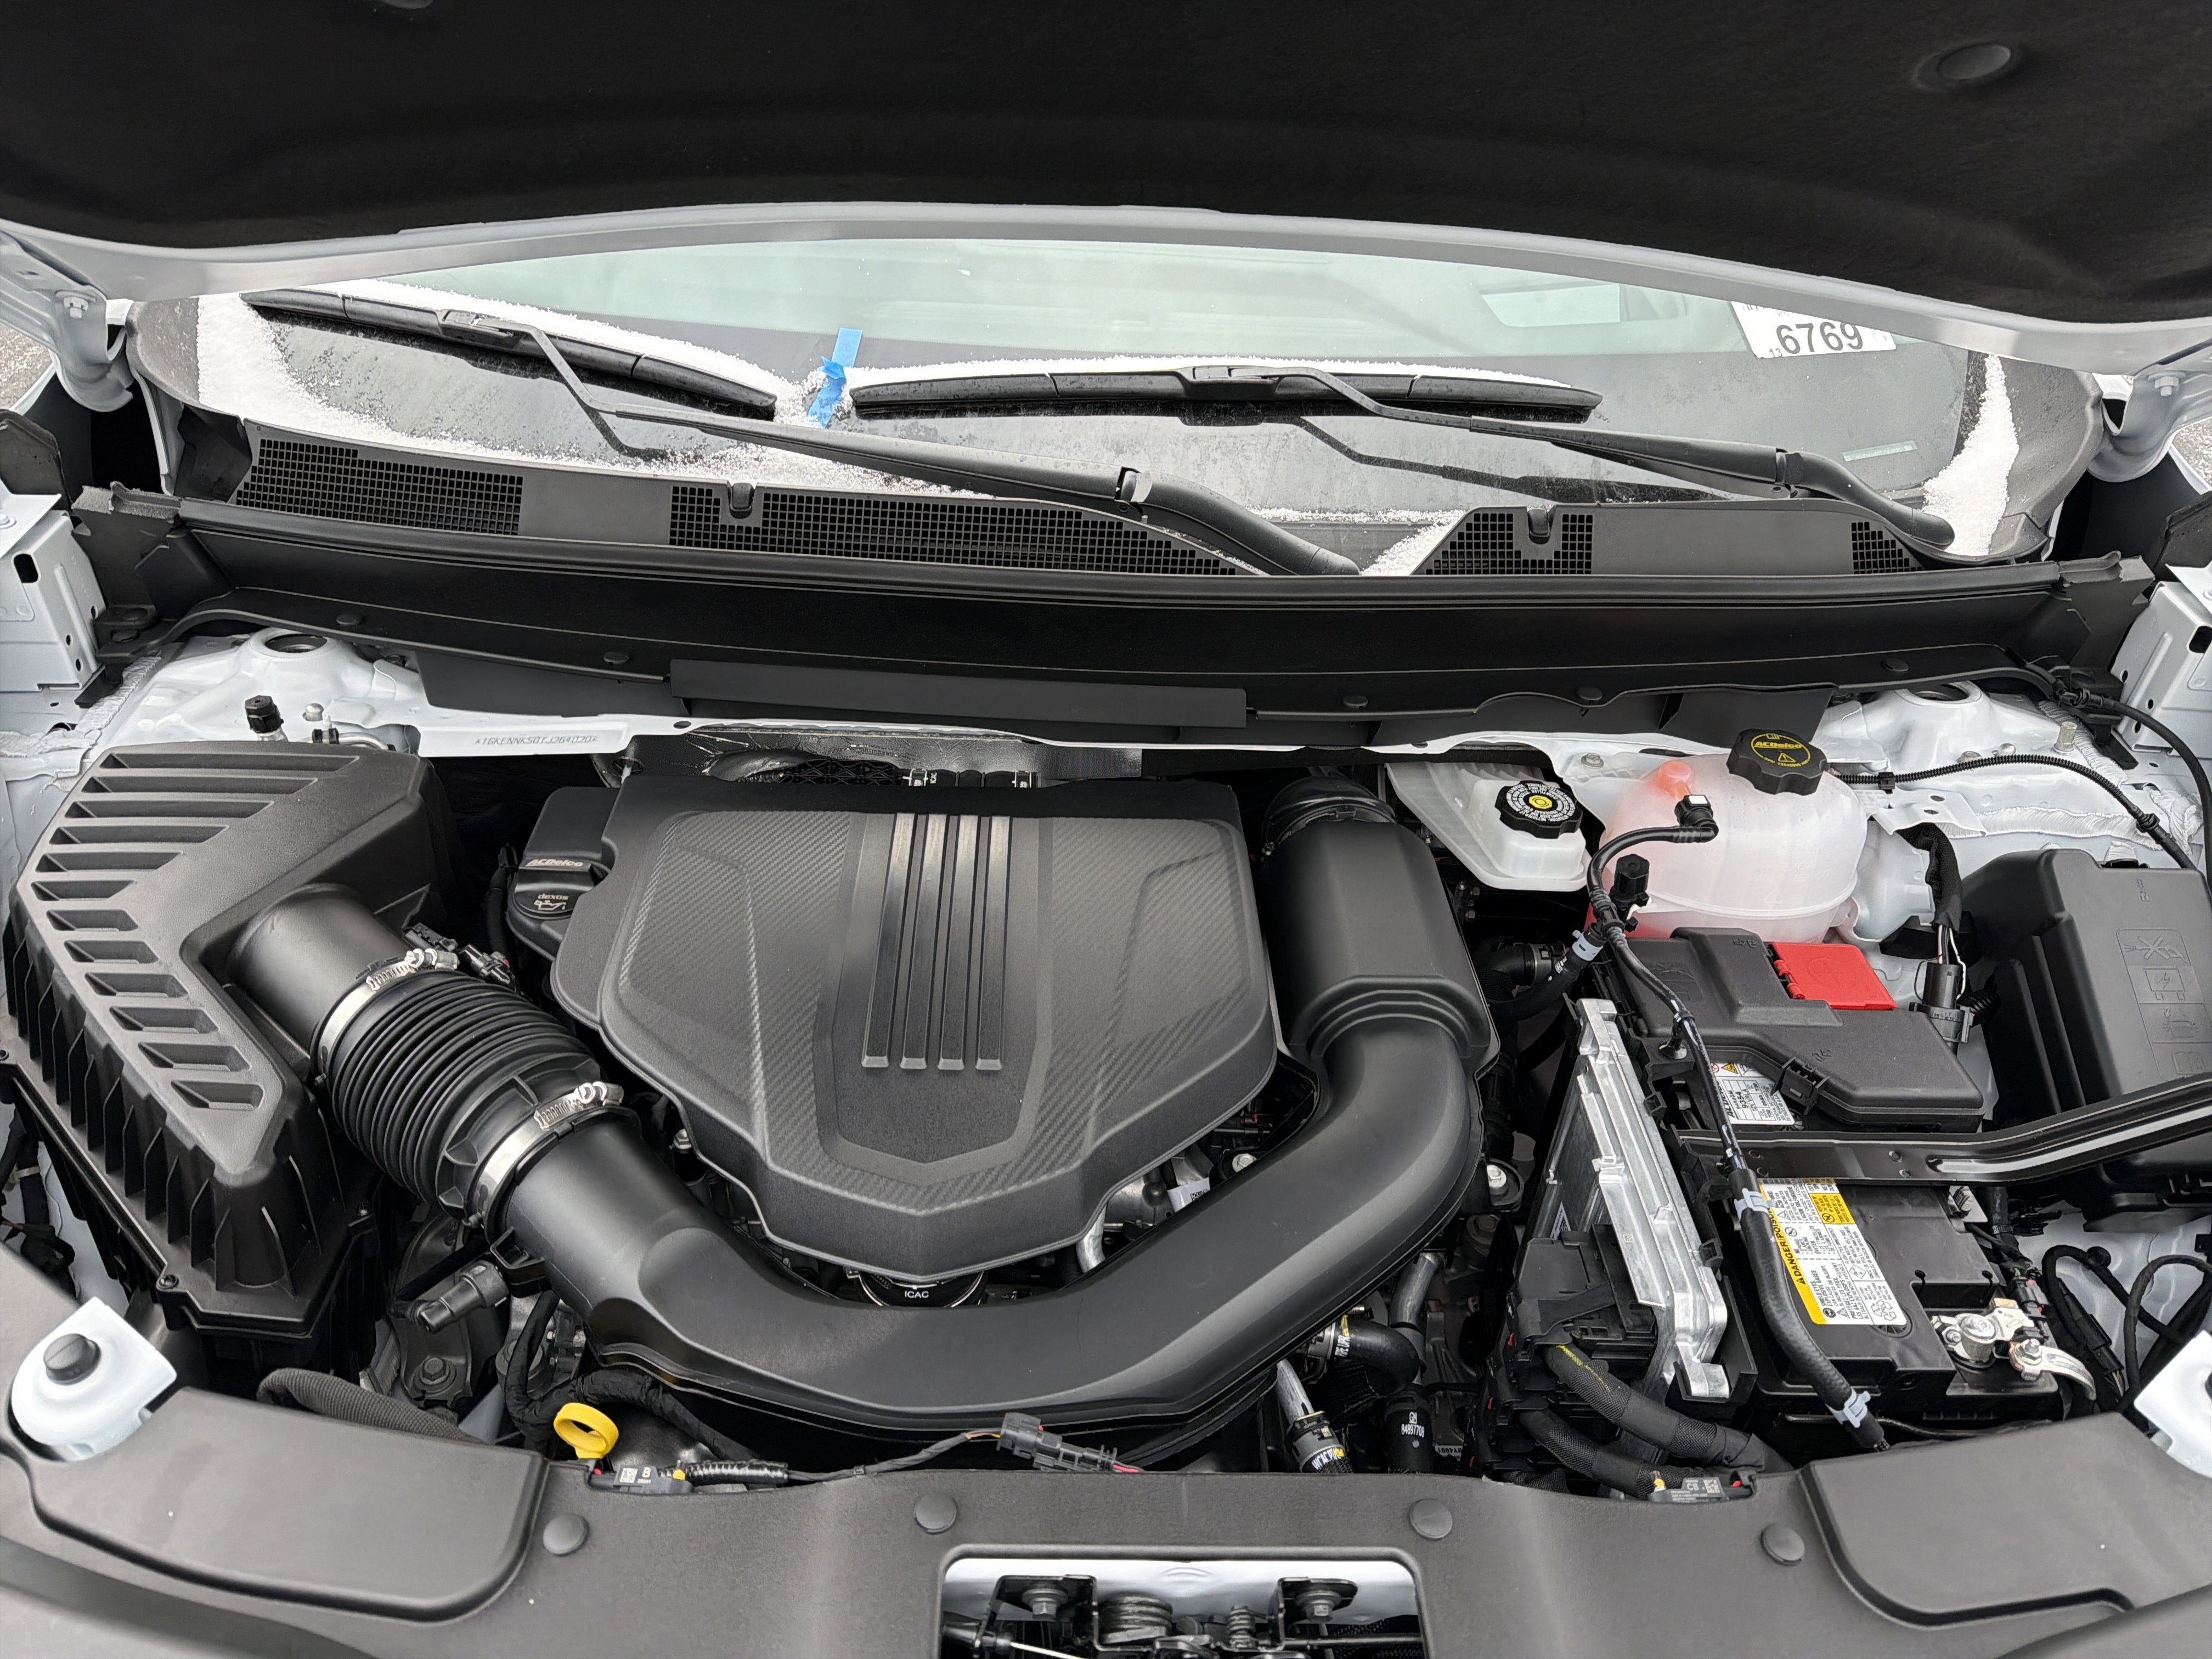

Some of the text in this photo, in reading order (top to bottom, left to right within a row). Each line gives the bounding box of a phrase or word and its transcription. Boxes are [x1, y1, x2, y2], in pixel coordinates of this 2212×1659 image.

[1776, 321, 1863, 354] 6769
[526, 859, 584, 867] ACDelco
[1734, 1091, 1750, 1108] 9354
[904, 1290, 929, 1299] ICAC
[1401, 1424, 1425, 1438] 84897708
